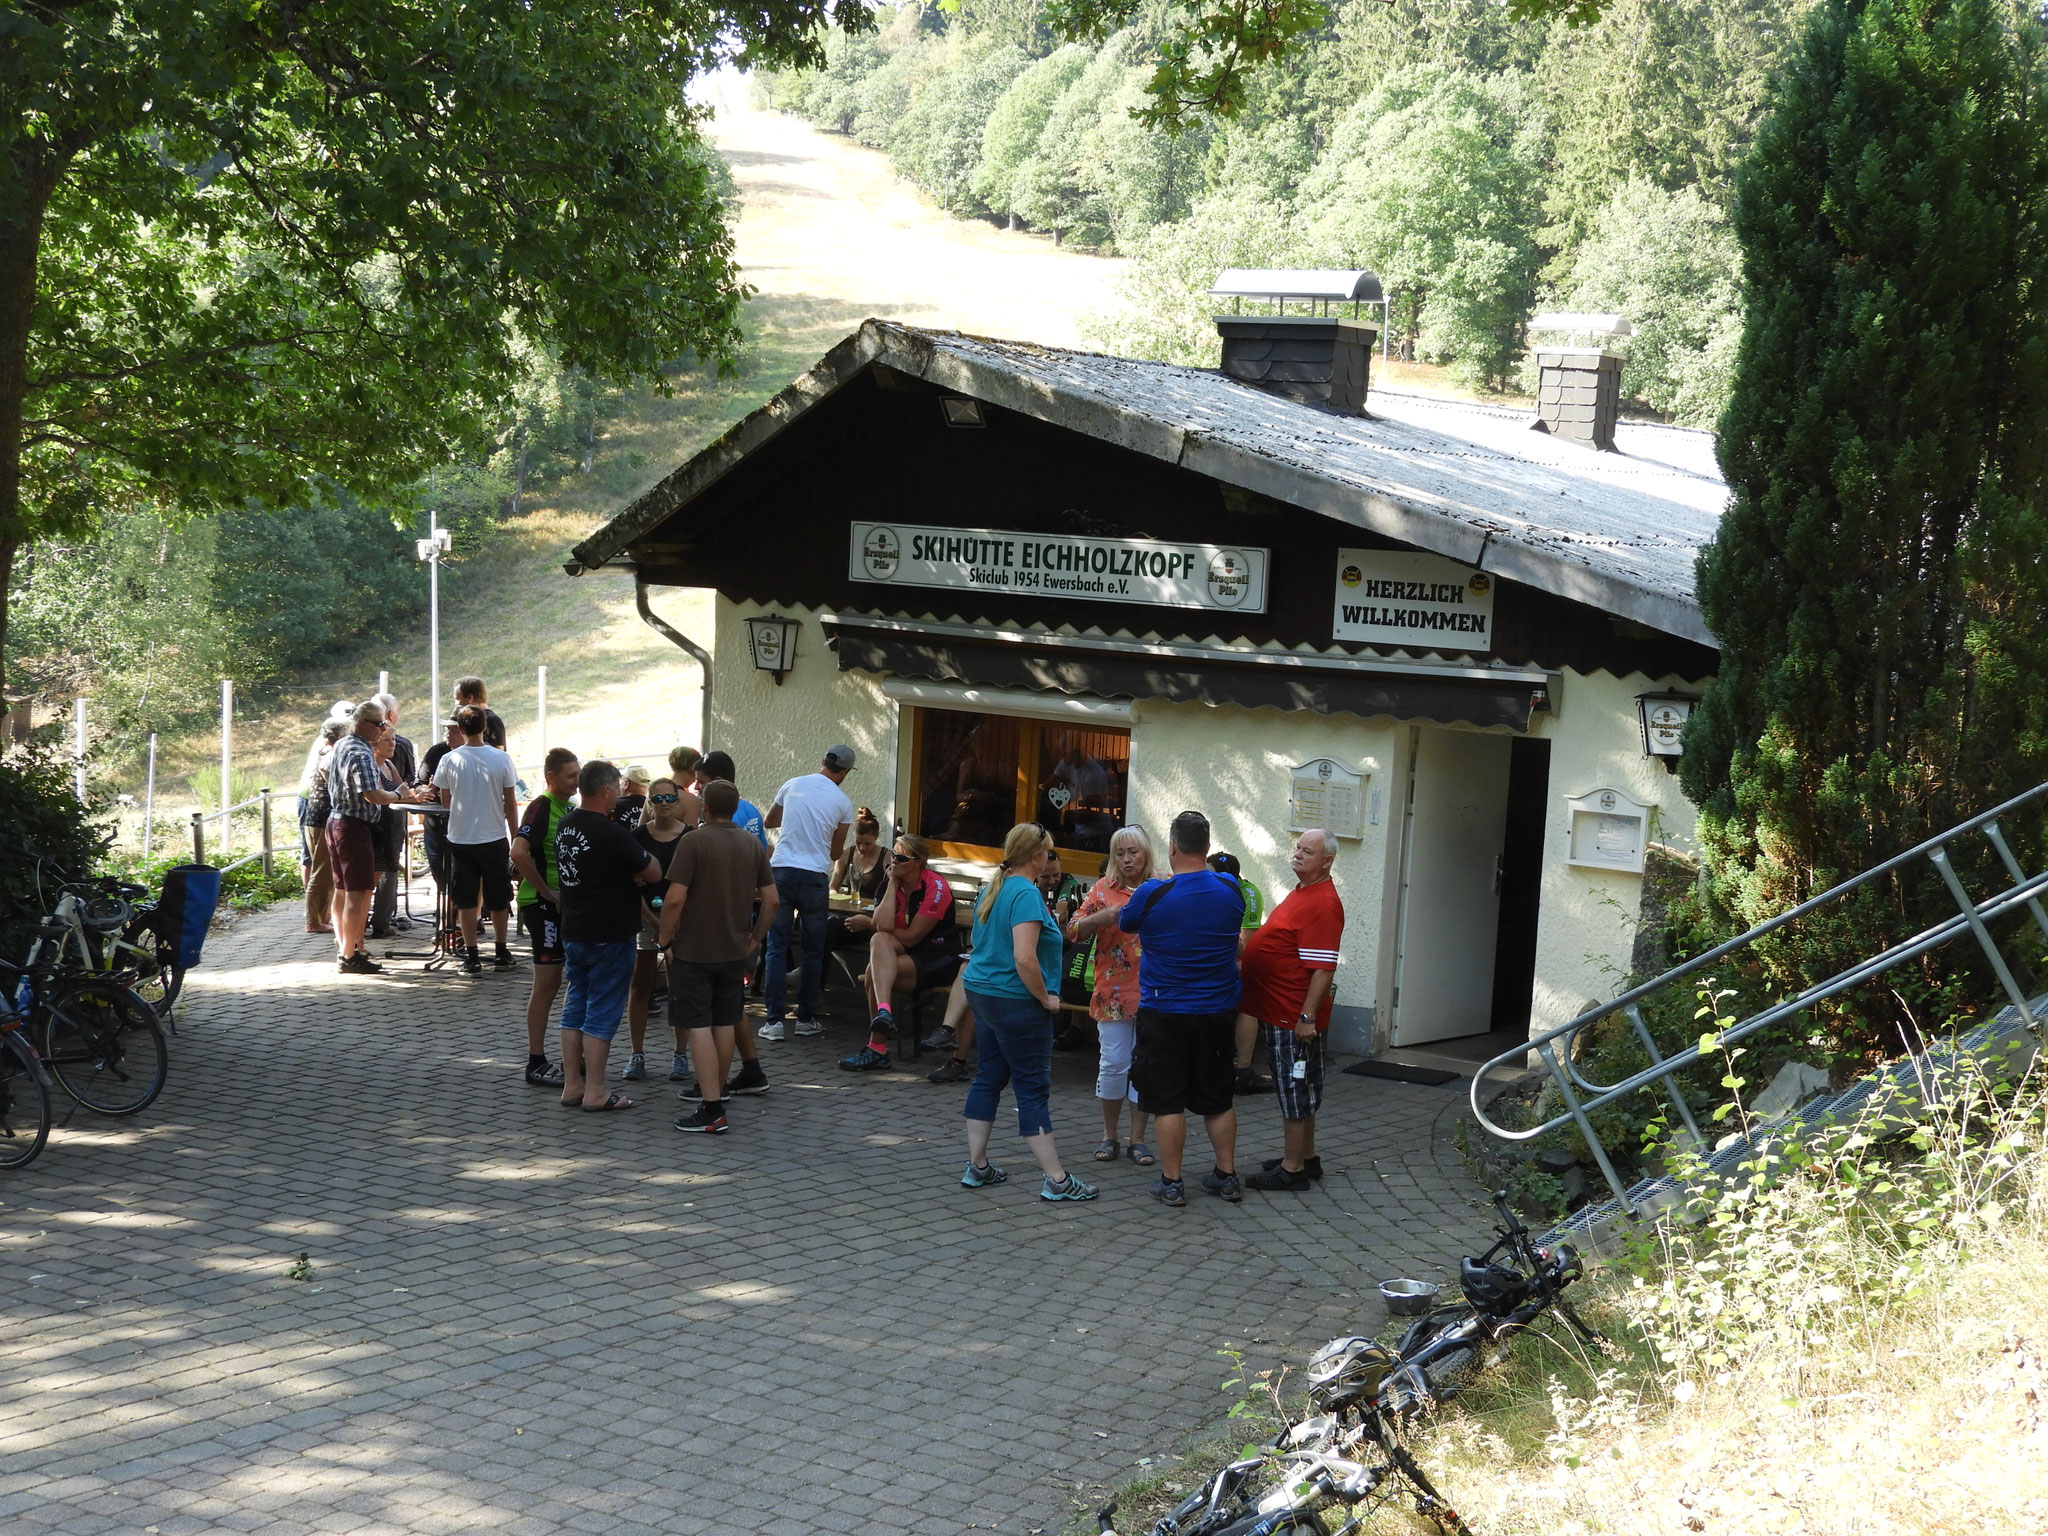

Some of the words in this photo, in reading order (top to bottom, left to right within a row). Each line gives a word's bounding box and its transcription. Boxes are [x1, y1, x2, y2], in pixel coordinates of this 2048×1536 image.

[911, 535, 1014, 567] SKIHÜTTE
[1022, 542, 1195, 580] EICHHOLZKOPF
[969, 567, 1009, 585] Skiclub
[1013, 571, 1040, 587] 1954
[1043, 573, 1104, 593] Ewersbach
[1107, 579, 1129, 595] e.V.
[1366, 579, 1464, 604] HERZLICH
[1342, 605, 1486, 633] WILLKOMMEN
[1069, 952, 1085, 979] Rhön
